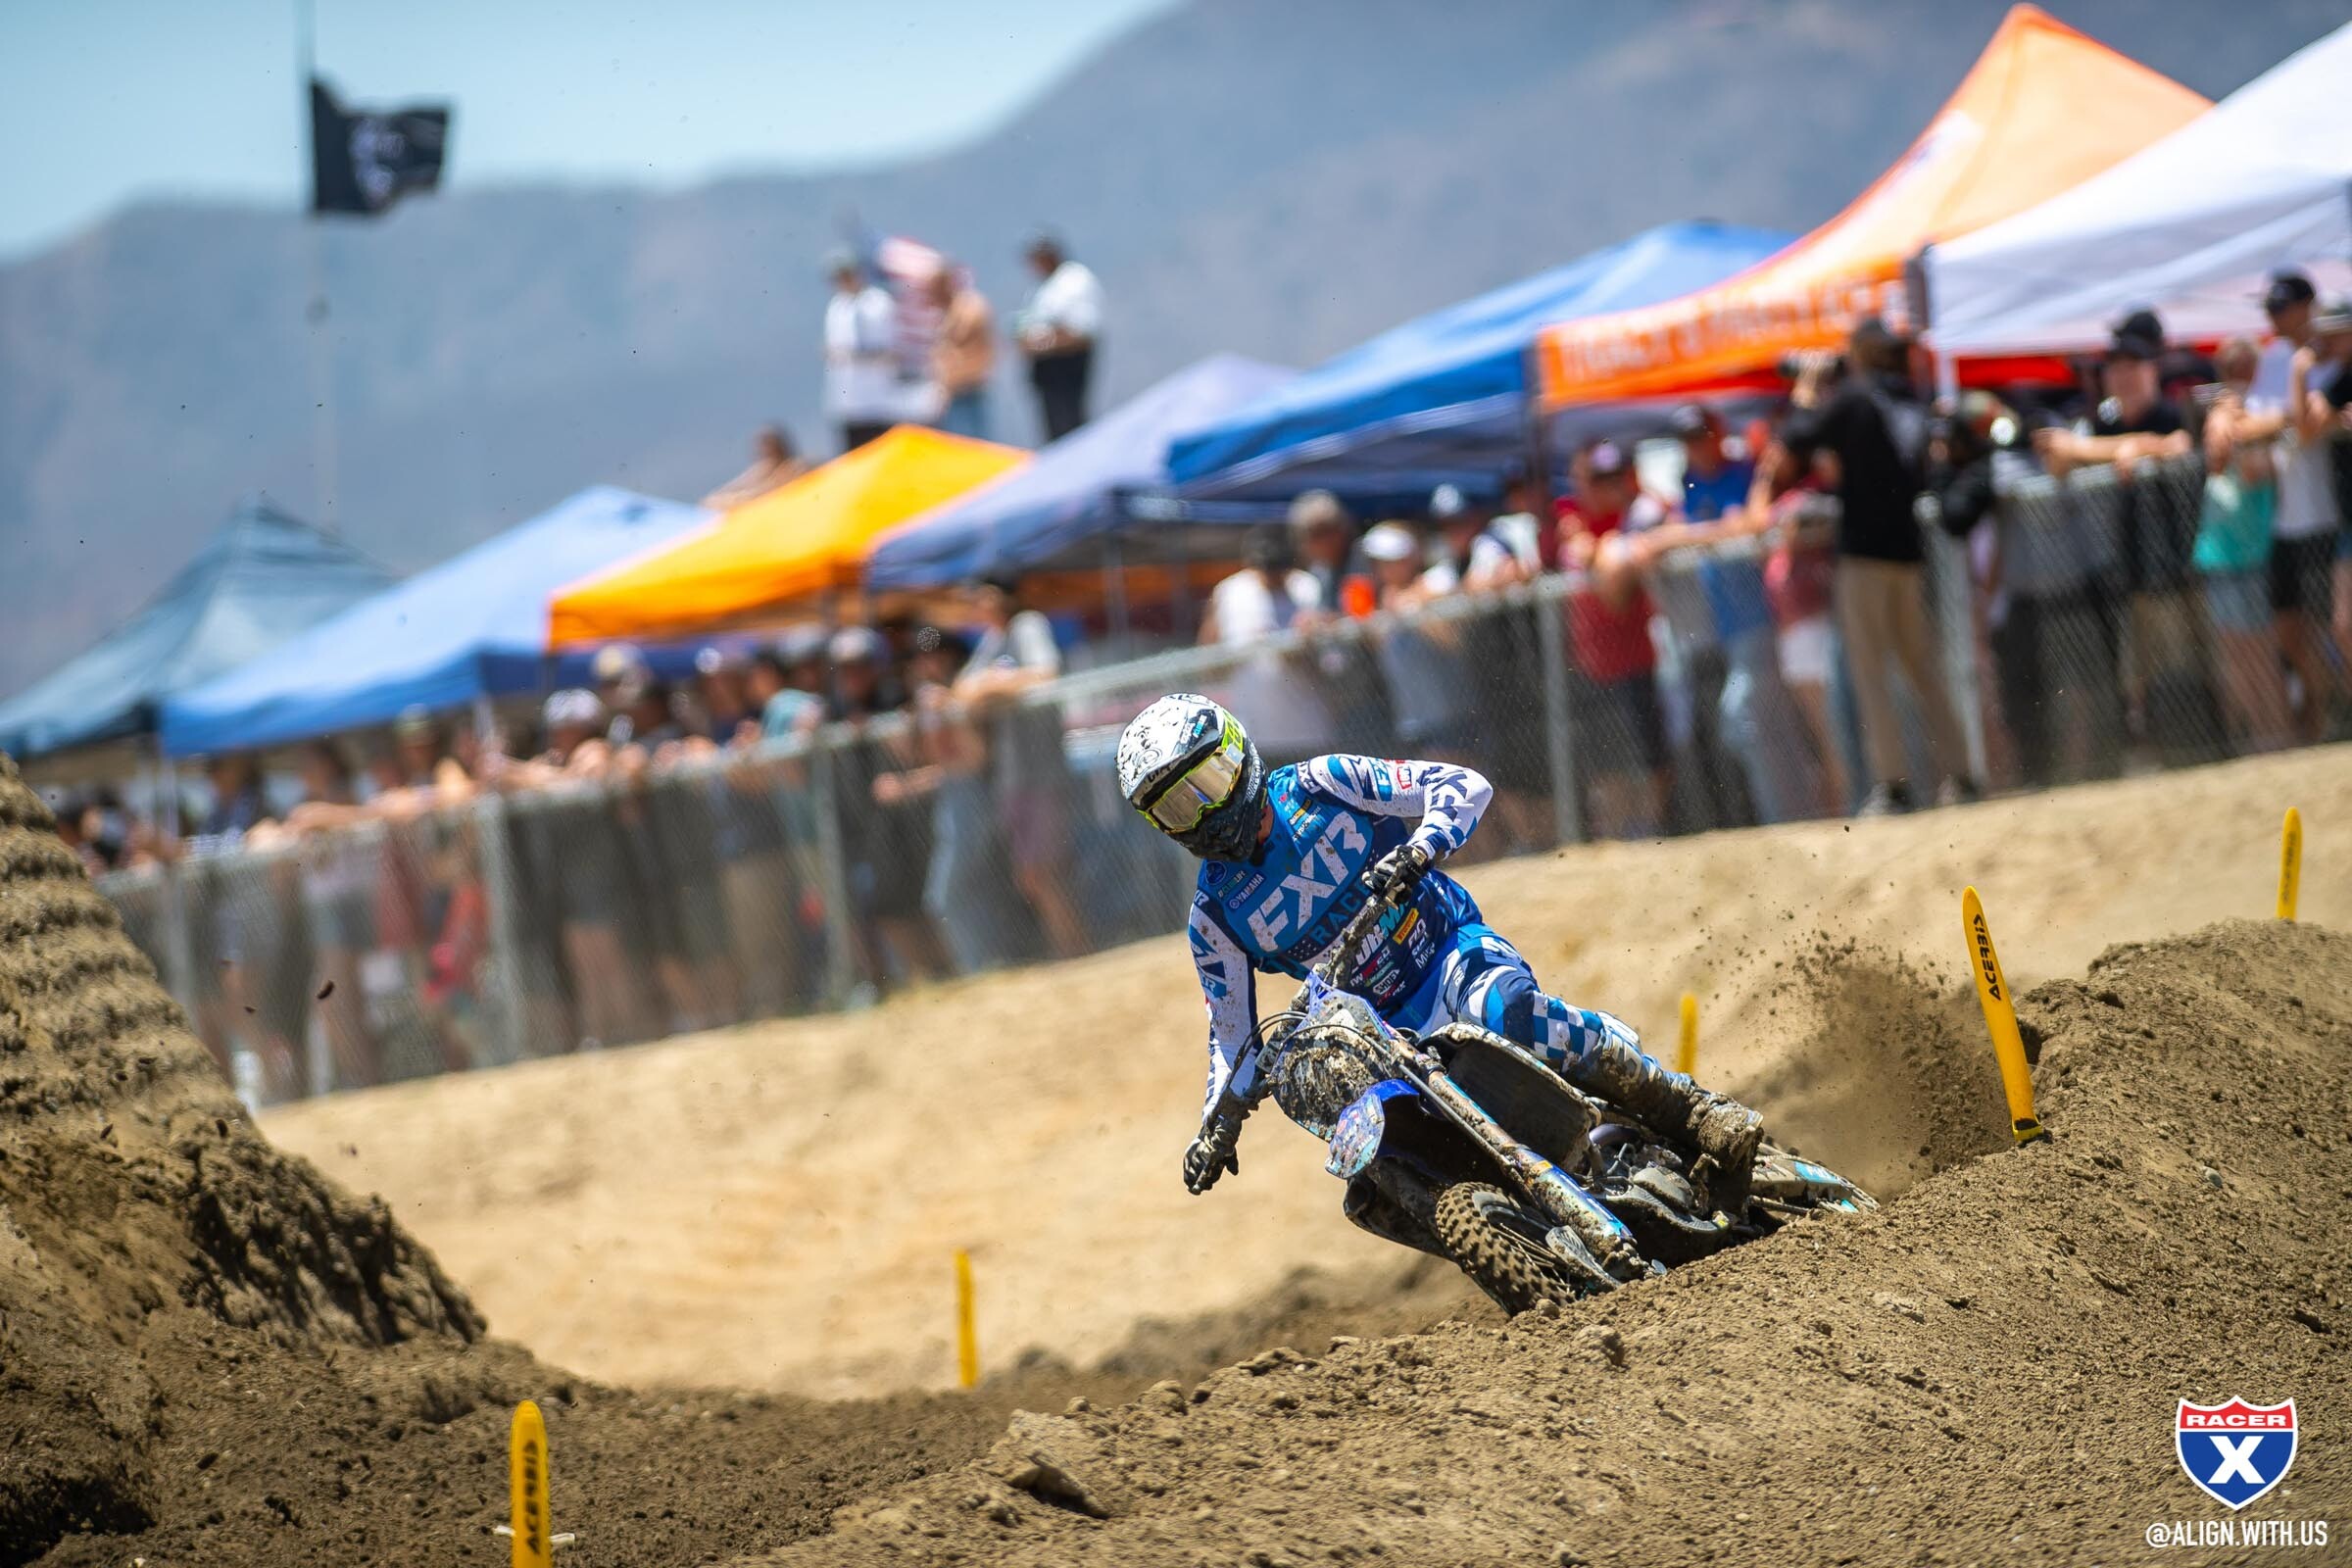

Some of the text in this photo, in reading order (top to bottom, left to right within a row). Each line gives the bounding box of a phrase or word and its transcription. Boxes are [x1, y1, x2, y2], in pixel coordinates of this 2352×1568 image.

[1236, 873, 1264, 902] YAMAHA
[1247, 811, 1367, 953] FXR
[1973, 914, 2001, 1001] ACERBIS
